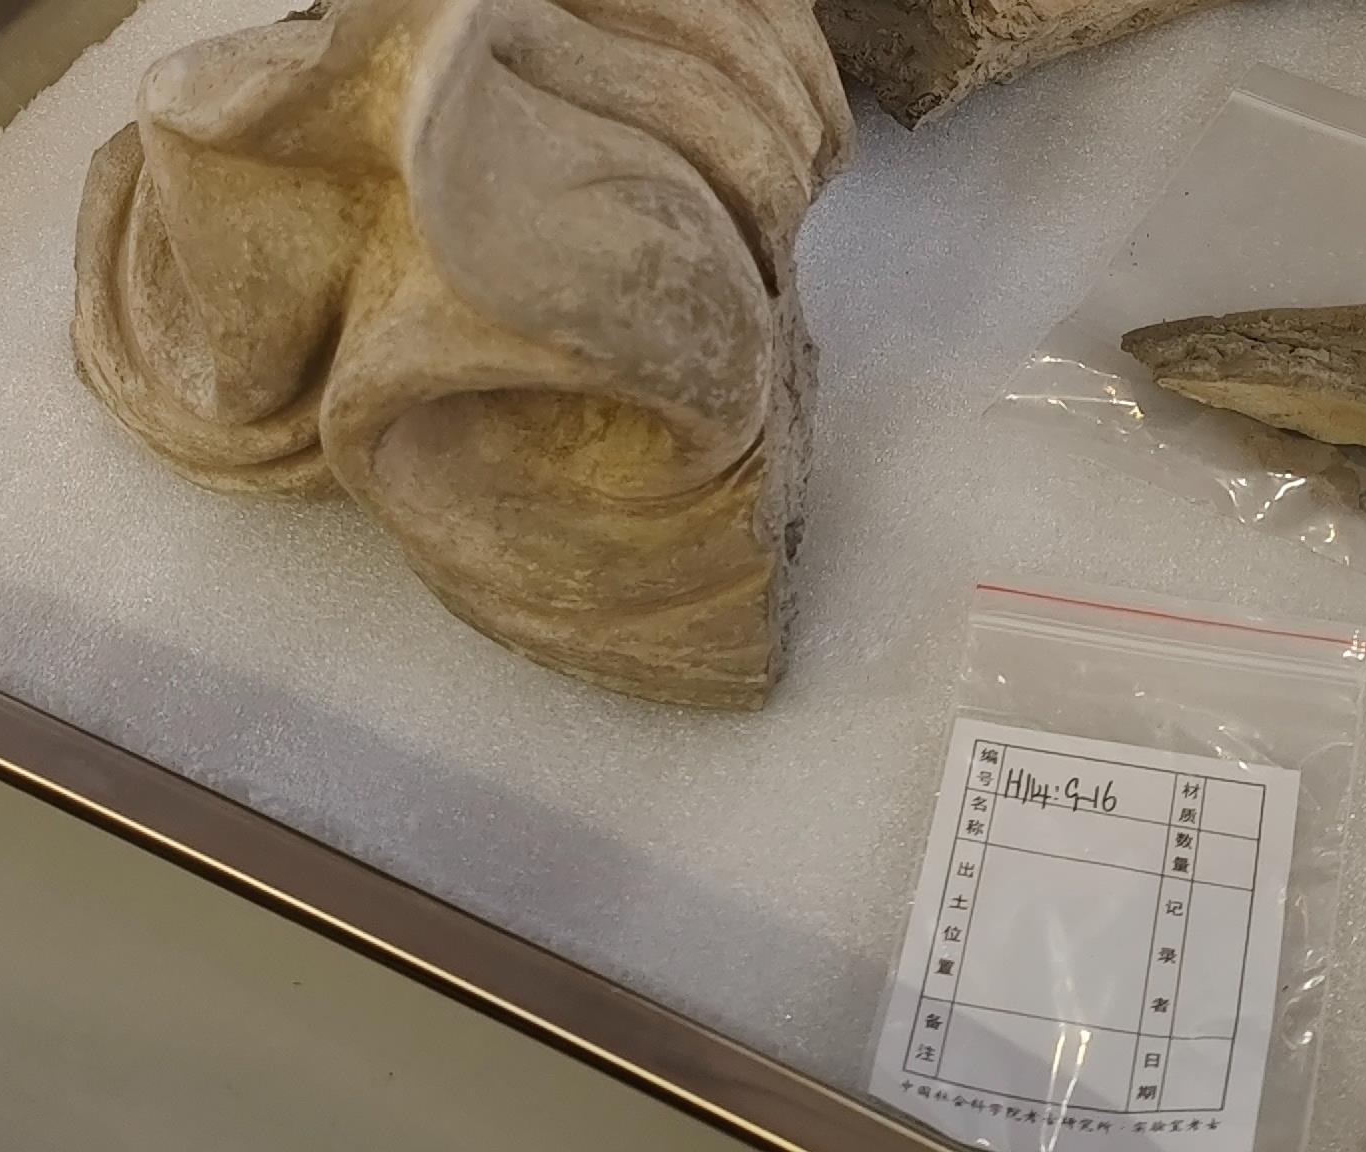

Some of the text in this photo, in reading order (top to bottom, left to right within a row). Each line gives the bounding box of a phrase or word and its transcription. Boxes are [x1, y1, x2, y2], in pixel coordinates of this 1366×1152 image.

[976, 748, 999, 787] 编号
[966, 795, 988, 836] 名称
[1178, 781, 1200, 824] 材质
[1171, 831, 1194, 873] 数量
[933, 861, 976, 977] 出土位置
[1149, 899, 1184, 1014] 记录者
[914, 1013, 944, 1063] 备注
[1135, 1053, 1162, 1100] 日期
